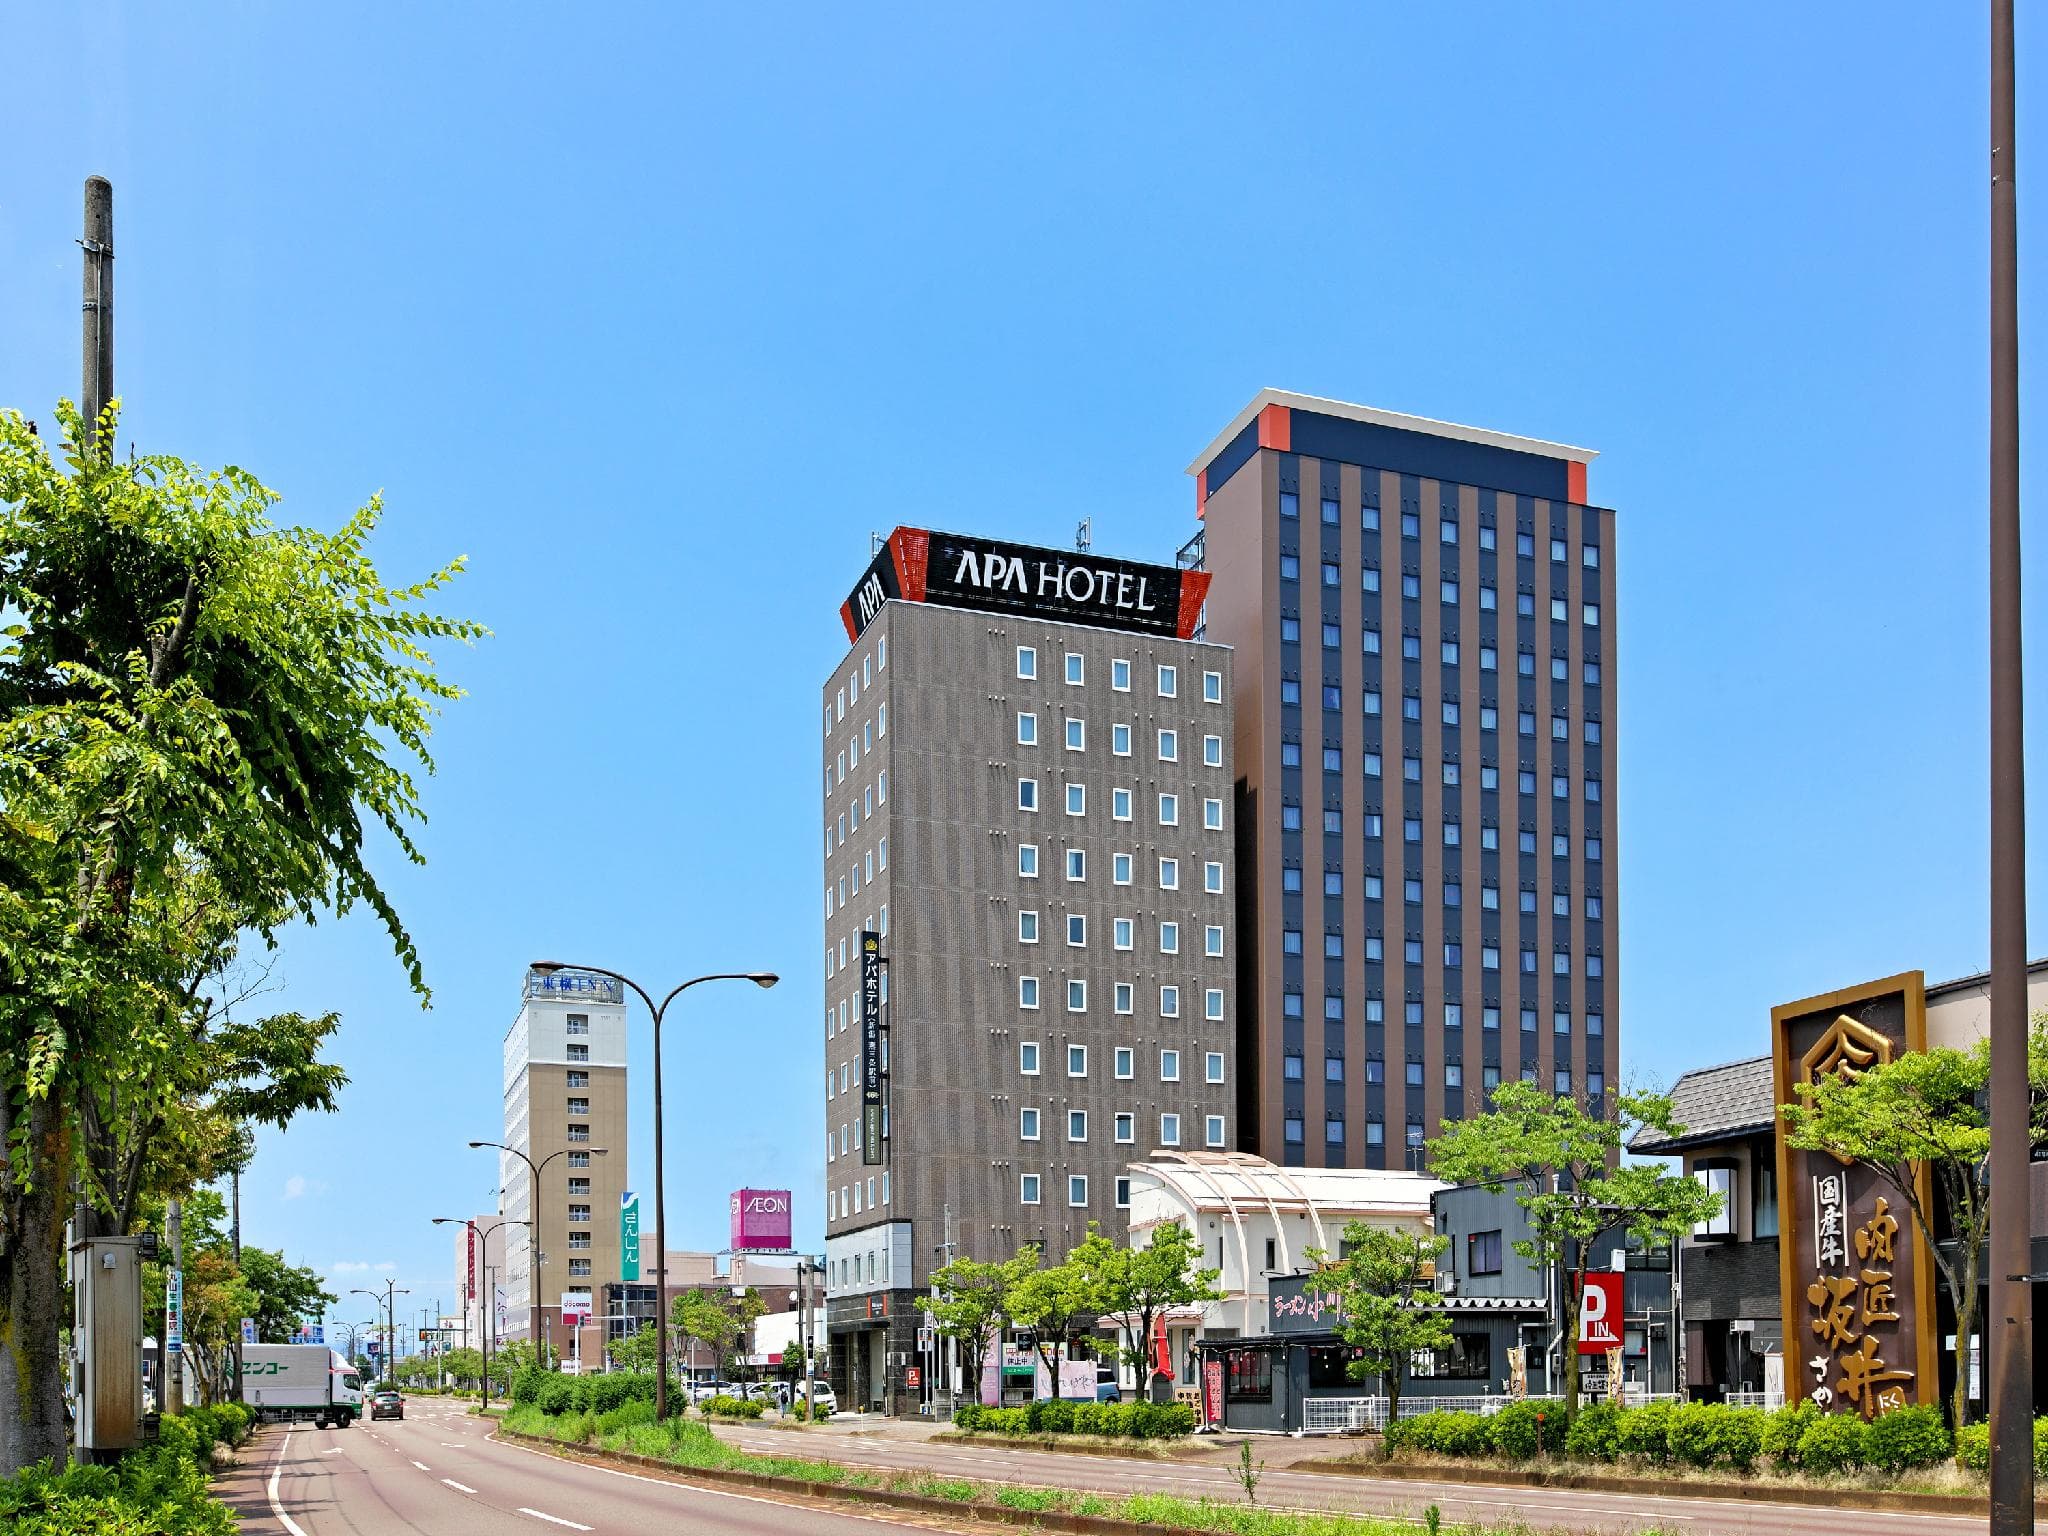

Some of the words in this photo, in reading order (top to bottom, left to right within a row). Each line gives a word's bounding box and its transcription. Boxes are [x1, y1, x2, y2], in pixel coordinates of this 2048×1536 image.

[857, 572, 885, 627] APA
[955, 550, 1028, 593] APA
[1036, 561, 1156, 611] HOTEL
[864, 953, 879, 1015] アパホテル
[624, 1211, 638, 1263] さんしん
[1819, 1175, 1844, 1267] 国産牛
[1274, 1295, 1306, 1319] ラーメン
[1579, 1284, 1607, 1342] P
[1594, 1321, 1609, 1337] IN
[908, 1370, 915, 1380] P
[1809, 1355, 1833, 1417] さか
